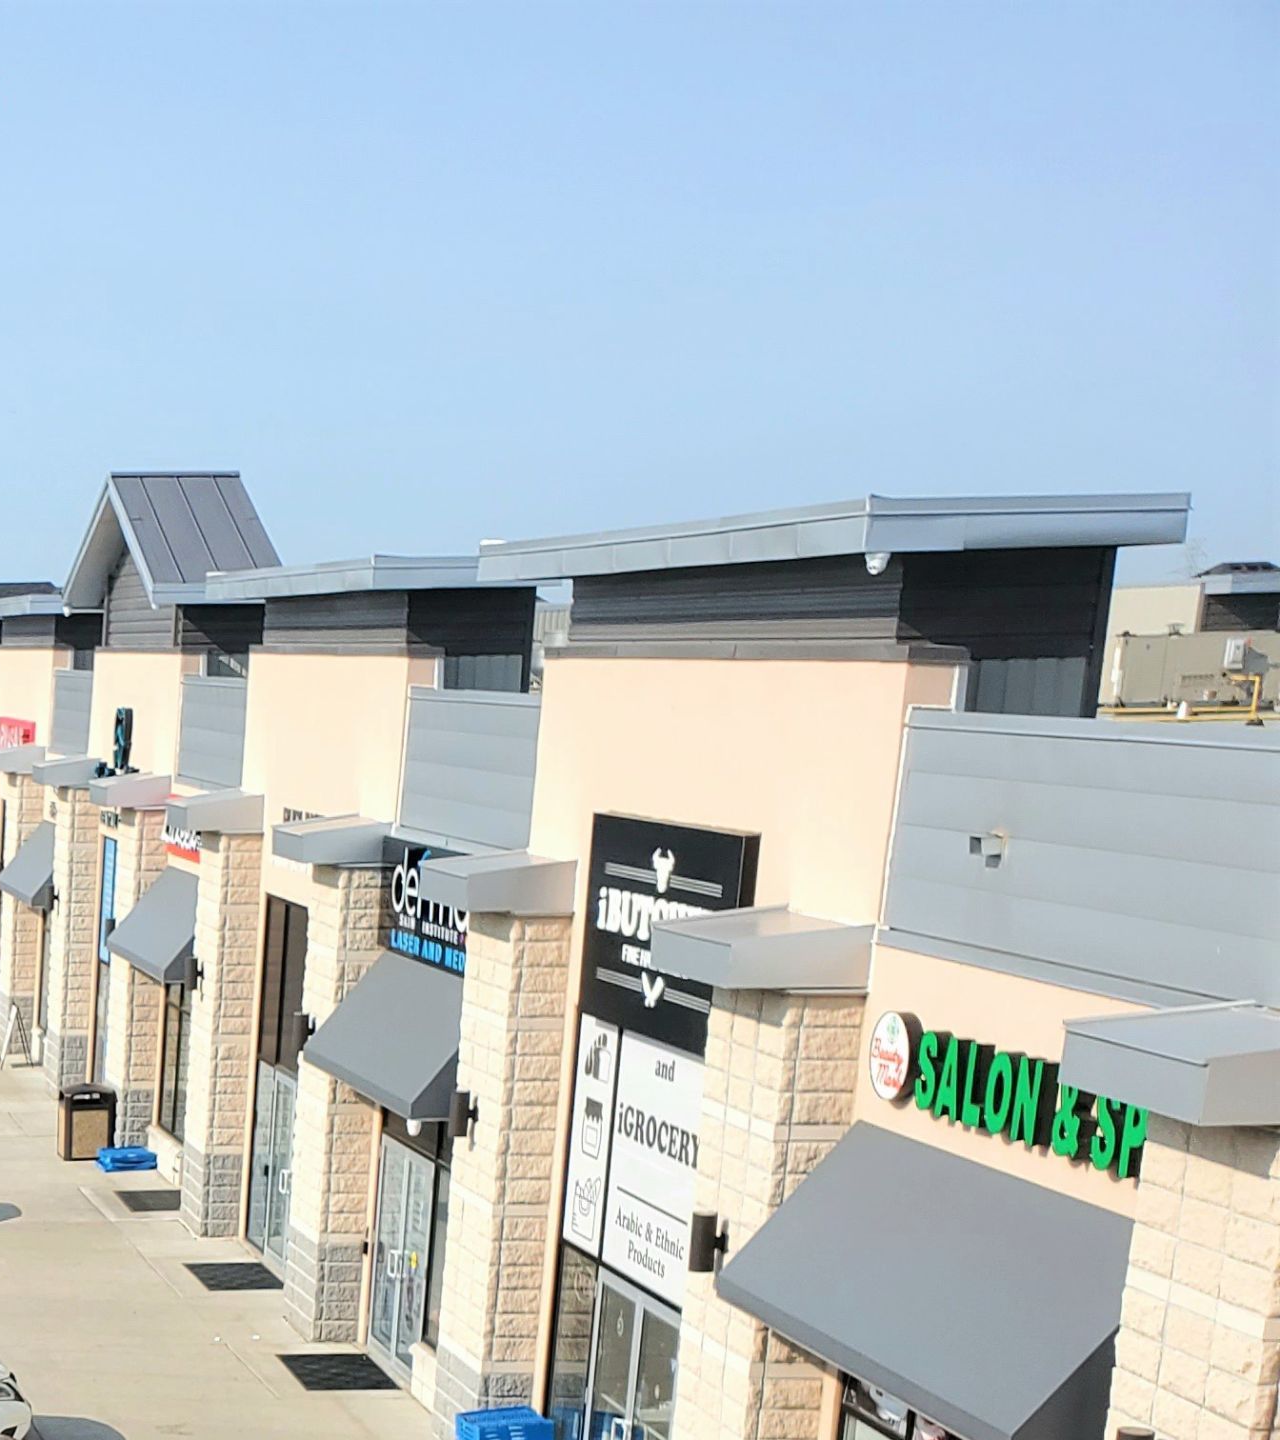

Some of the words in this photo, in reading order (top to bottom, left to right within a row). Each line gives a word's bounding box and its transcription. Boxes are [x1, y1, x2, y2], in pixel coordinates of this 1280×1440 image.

[391, 928, 419, 955] LASER
[422, 939, 442, 963] AND
[422, 921, 458, 945] INSTITUTE
[655, 1060, 676, 1082] and
[914, 1030, 1044, 1147] SALON
[1051, 1082, 1080, 1158] &
[617, 1102, 701, 1170] iGROCERY
[614, 1207, 643, 1237] Arabic
[645, 1222, 654, 1238] &
[654, 1224, 685, 1261] Ethnic
[627, 1240, 666, 1279] Products
